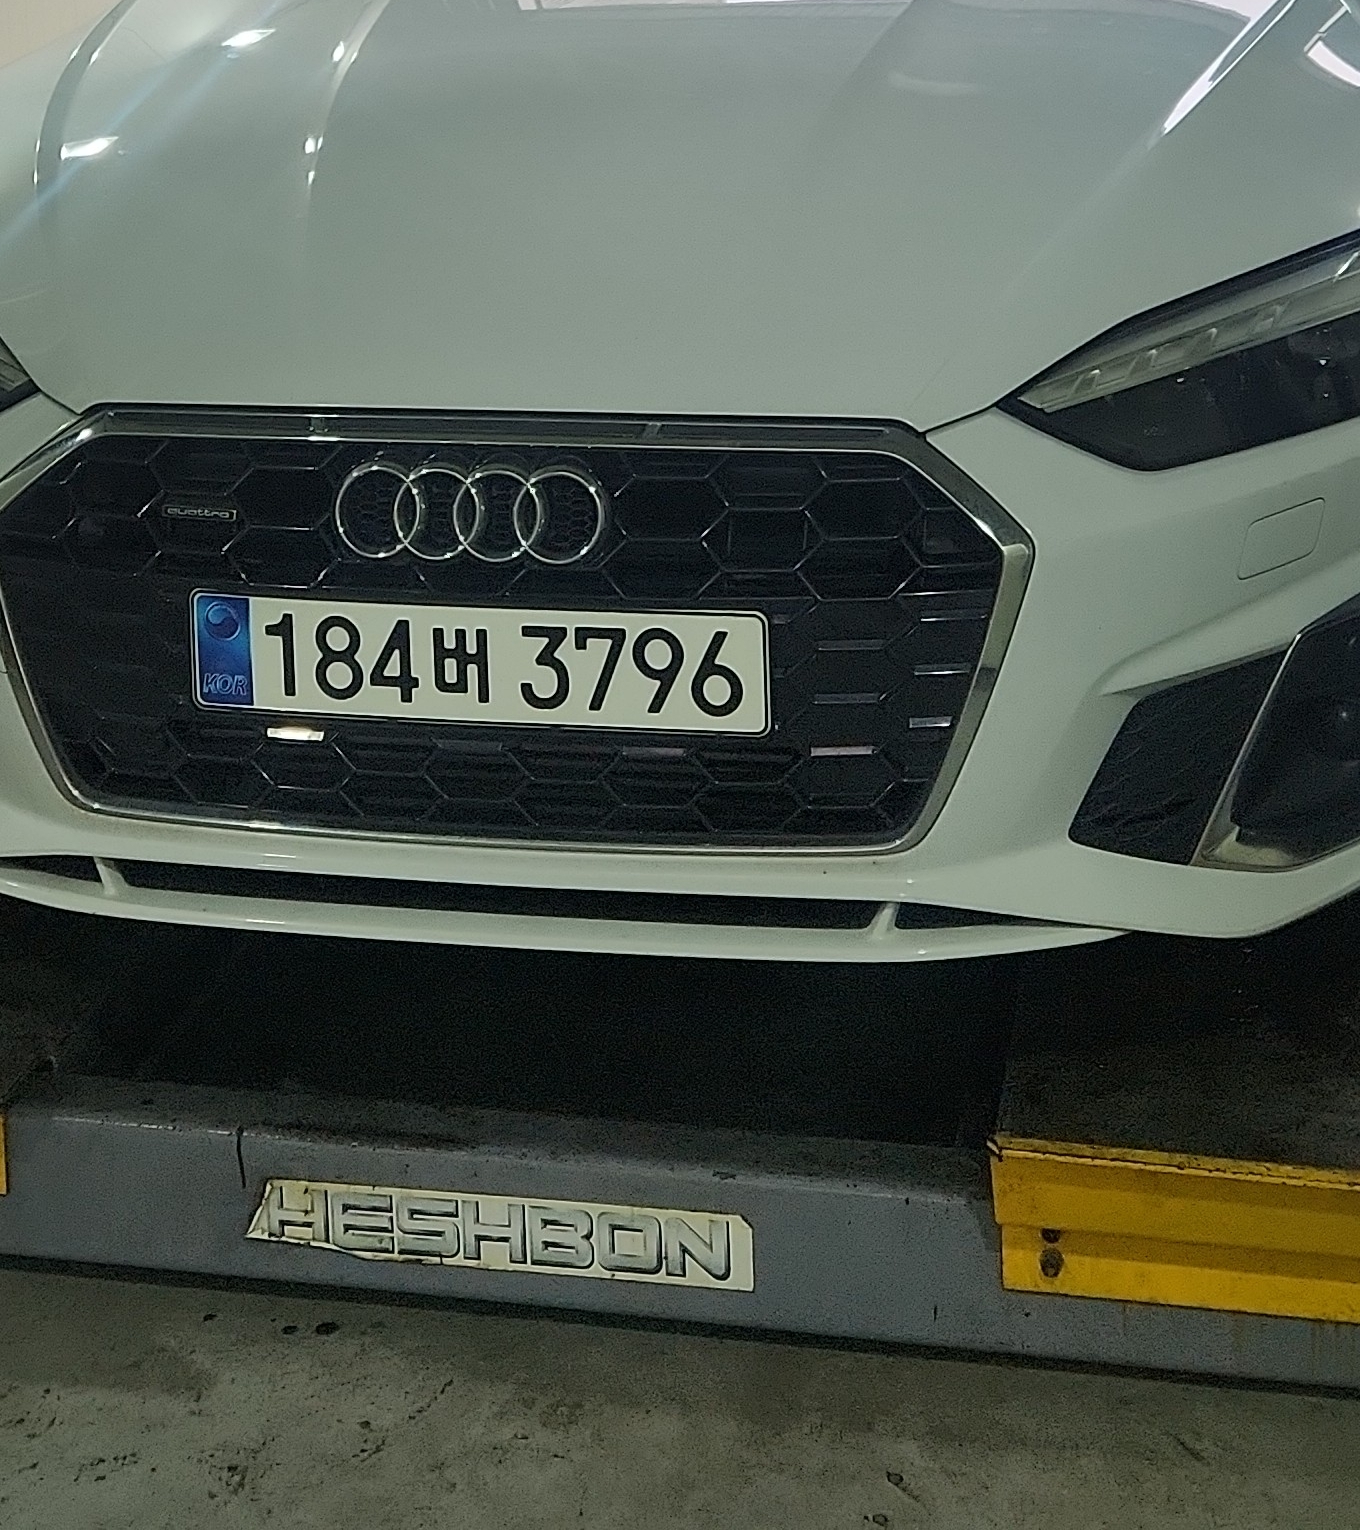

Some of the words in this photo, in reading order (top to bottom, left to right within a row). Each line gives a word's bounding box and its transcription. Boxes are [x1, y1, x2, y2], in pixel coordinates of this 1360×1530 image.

[167, 507, 230, 519] quattro
[202, 672, 248, 698] KOR
[263, 612, 490, 705] 184버
[520, 624, 744, 718] 3796
[266, 1184, 733, 1282] HESHBON
